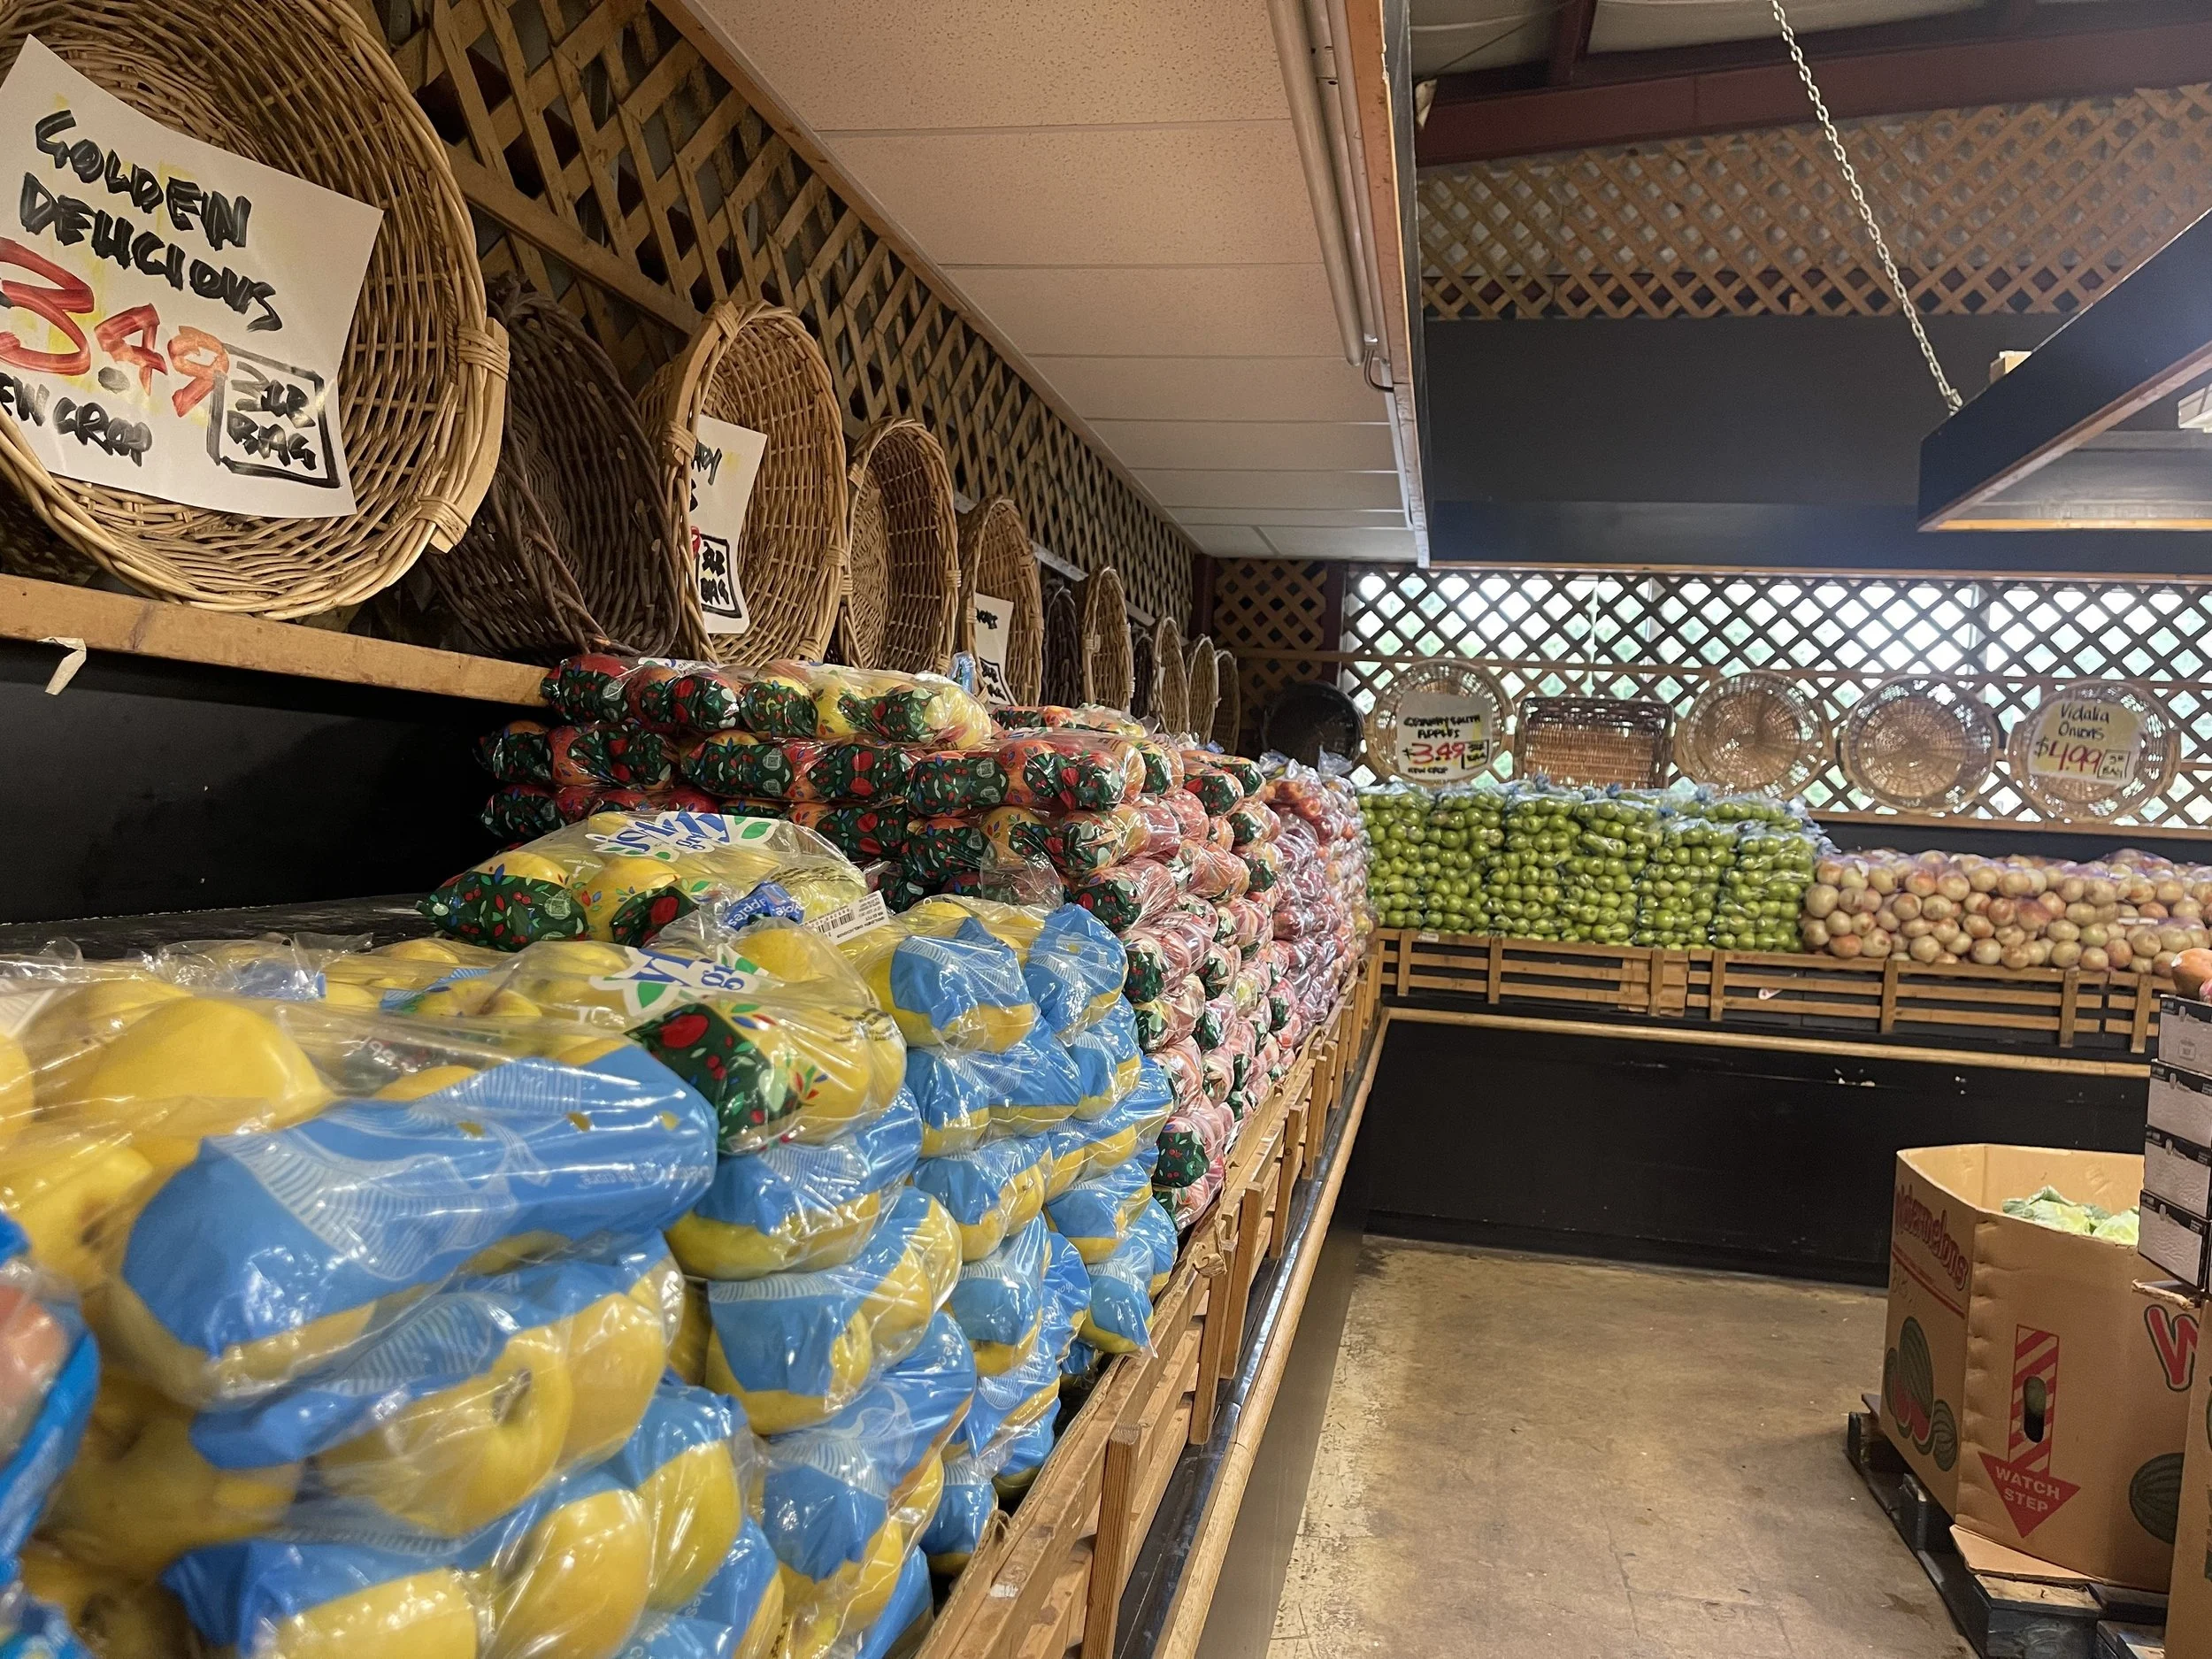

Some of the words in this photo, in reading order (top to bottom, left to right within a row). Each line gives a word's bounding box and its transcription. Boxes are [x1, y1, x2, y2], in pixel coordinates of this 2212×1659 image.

[35, 109, 251, 250] GOLDEN
[19, 173, 282, 332] DELICIOUS
[0, 237, 229, 418] 3.49
[52, 396, 152, 467] CROP
[2058, 721, 2104, 741] Onions
[2060, 703, 2109, 724] Vidalia
[1417, 728, 1461, 739] APPLES
[1402, 741, 1465, 765] $3.49
[2033, 734, 2102, 775] $4.99
[1995, 1465, 2061, 1501] WATCH
[2003, 1487, 2048, 1512] STEP
